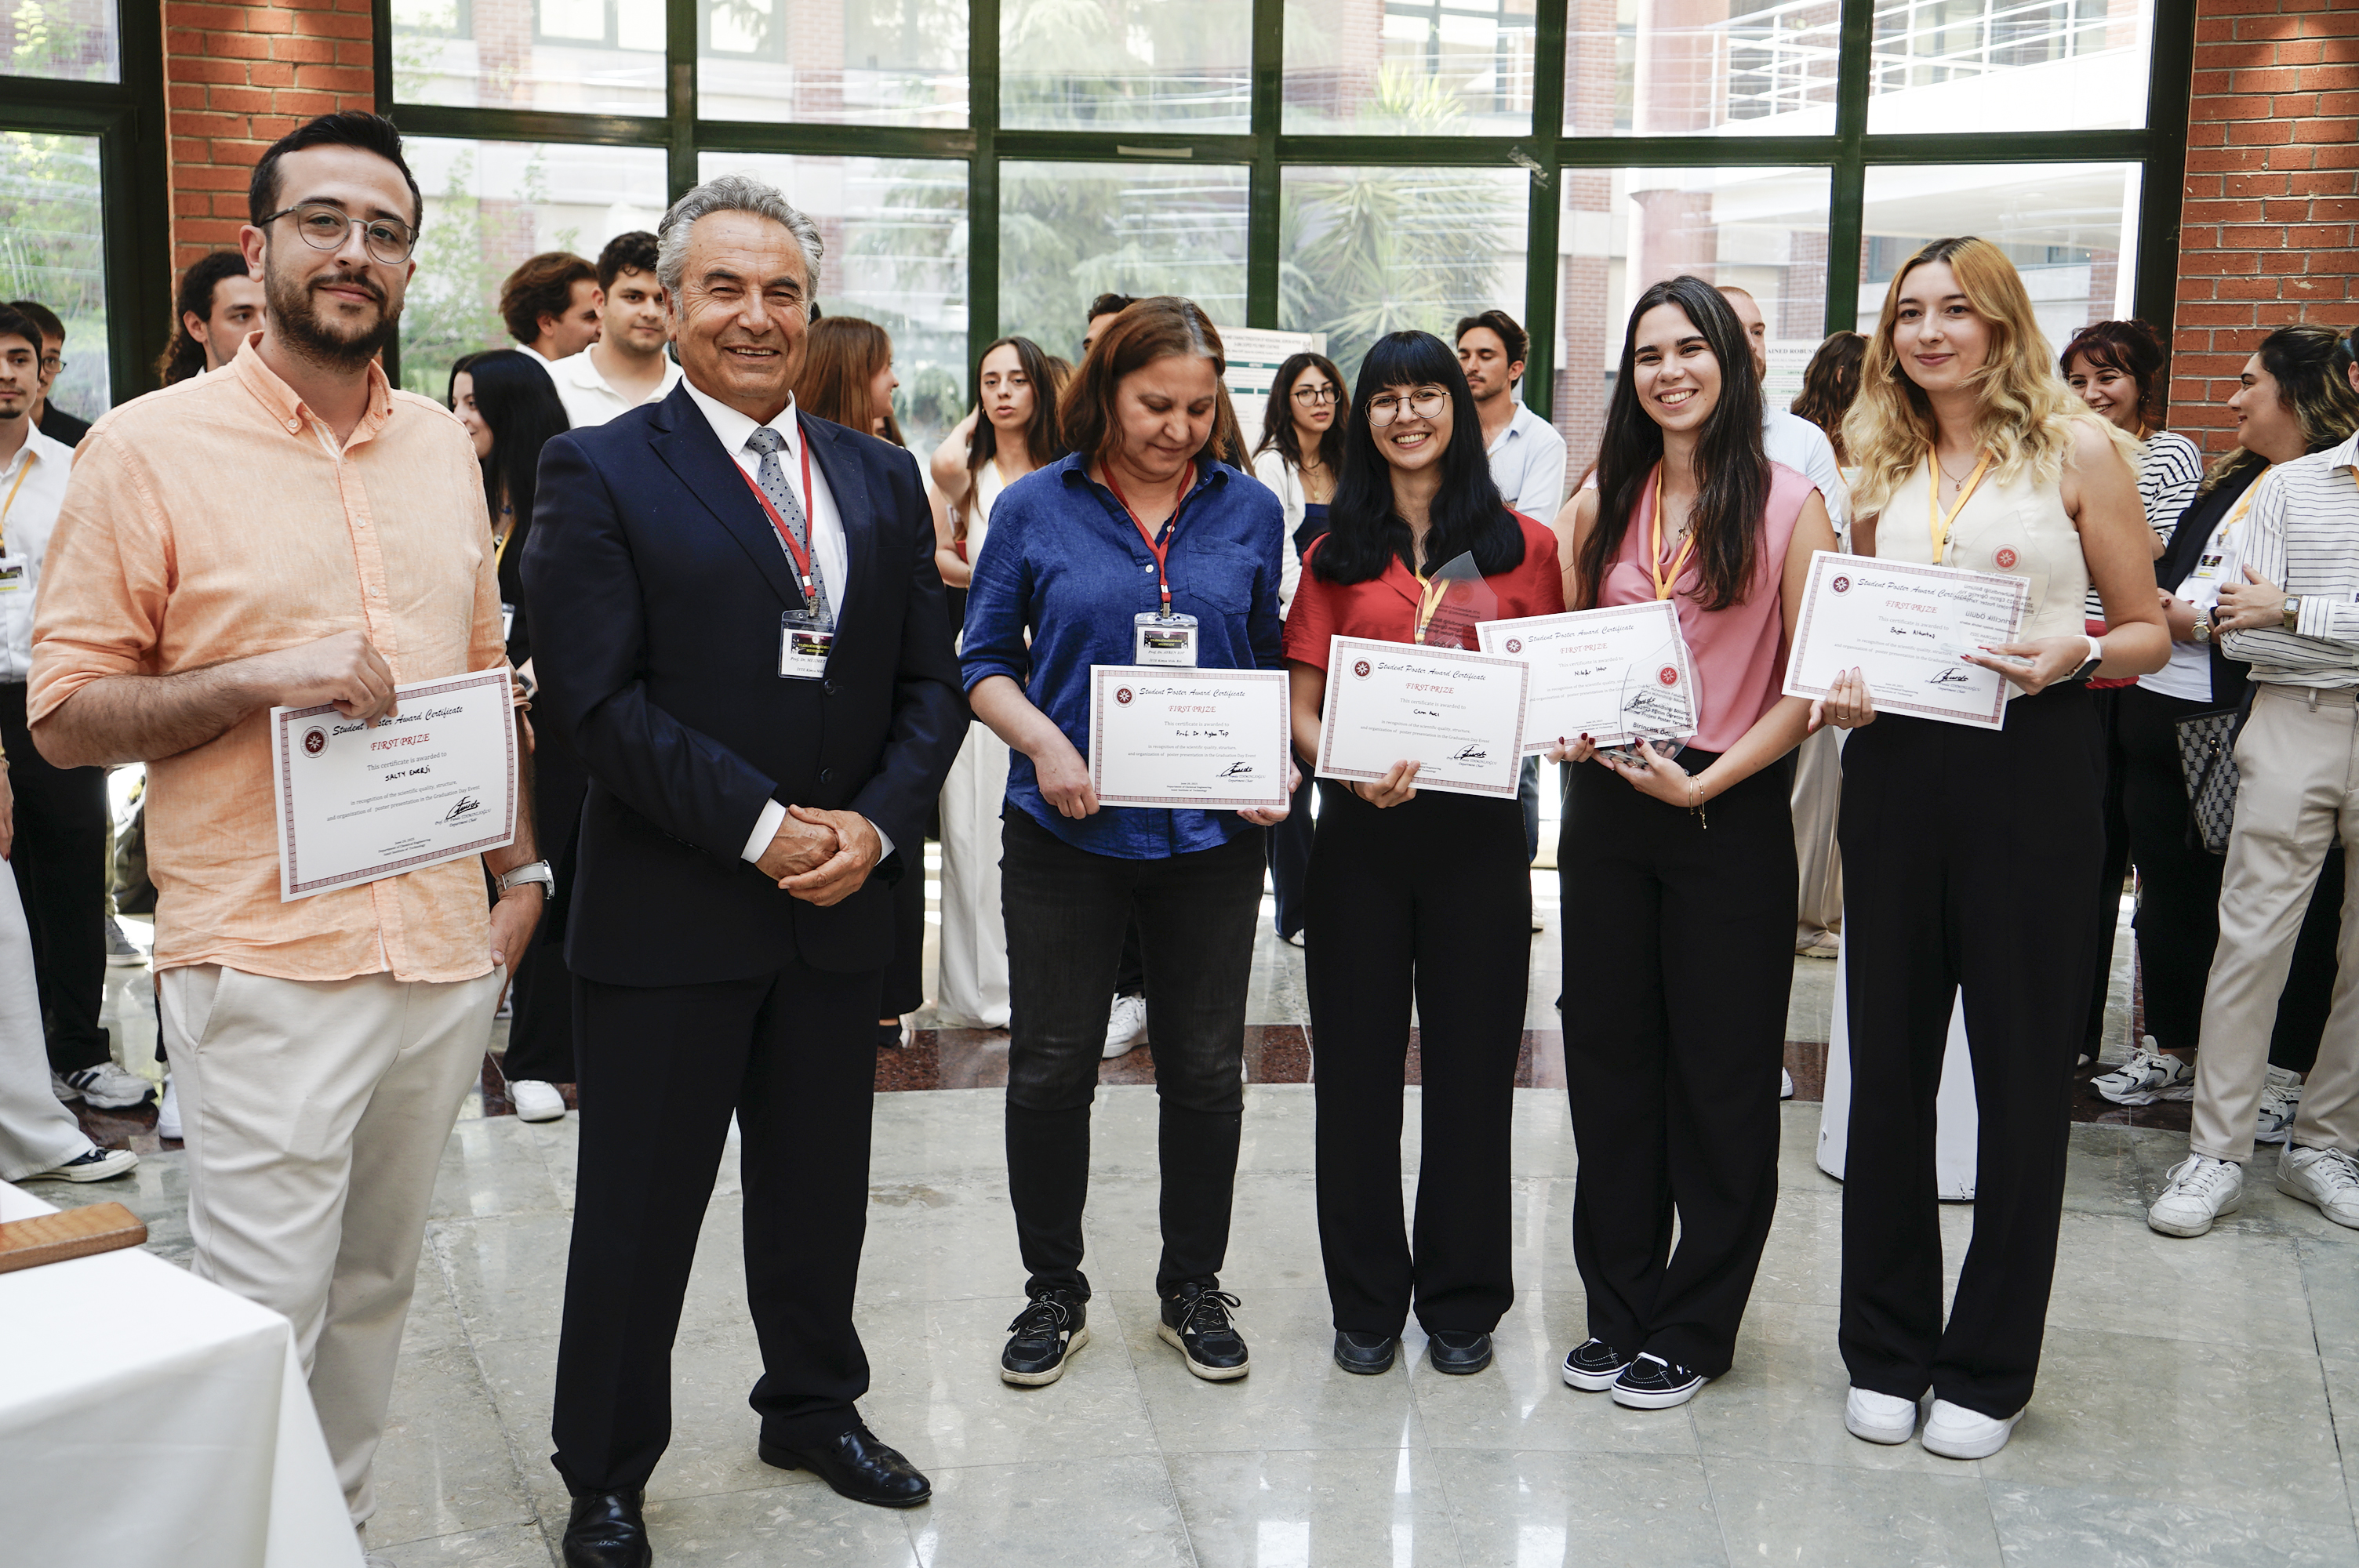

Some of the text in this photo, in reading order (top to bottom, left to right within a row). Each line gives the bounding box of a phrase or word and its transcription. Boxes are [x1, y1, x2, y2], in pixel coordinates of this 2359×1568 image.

[1857, 578, 1886, 588] Student
[1888, 582, 1909, 591] Poster
[1910, 586, 1936, 595] Award
[1885, 600, 1938, 614] FIRST PRIZE
[1528, 634, 1553, 643] Student
[1576, 628, 1599, 637] Award
[1601, 625, 1634, 634] Certificate
[1559, 642, 1608, 654] FIRST PRIZE
[1377, 662, 1486, 681] Student Poster Award Certificate
[1212, 688, 1245, 699] Certificate
[1405, 682, 1455, 695] FIRST PRIZE
[1168, 705, 1216, 713] FIRST PRIZE
[332, 706, 463, 736] Student ster Award Certificate
[1218, 729, 1229, 738] Top
[370, 733, 431, 751] FIRST PRIZE
[380, 759, 409, 769] certificate
[416, 752, 441, 762] awarded
